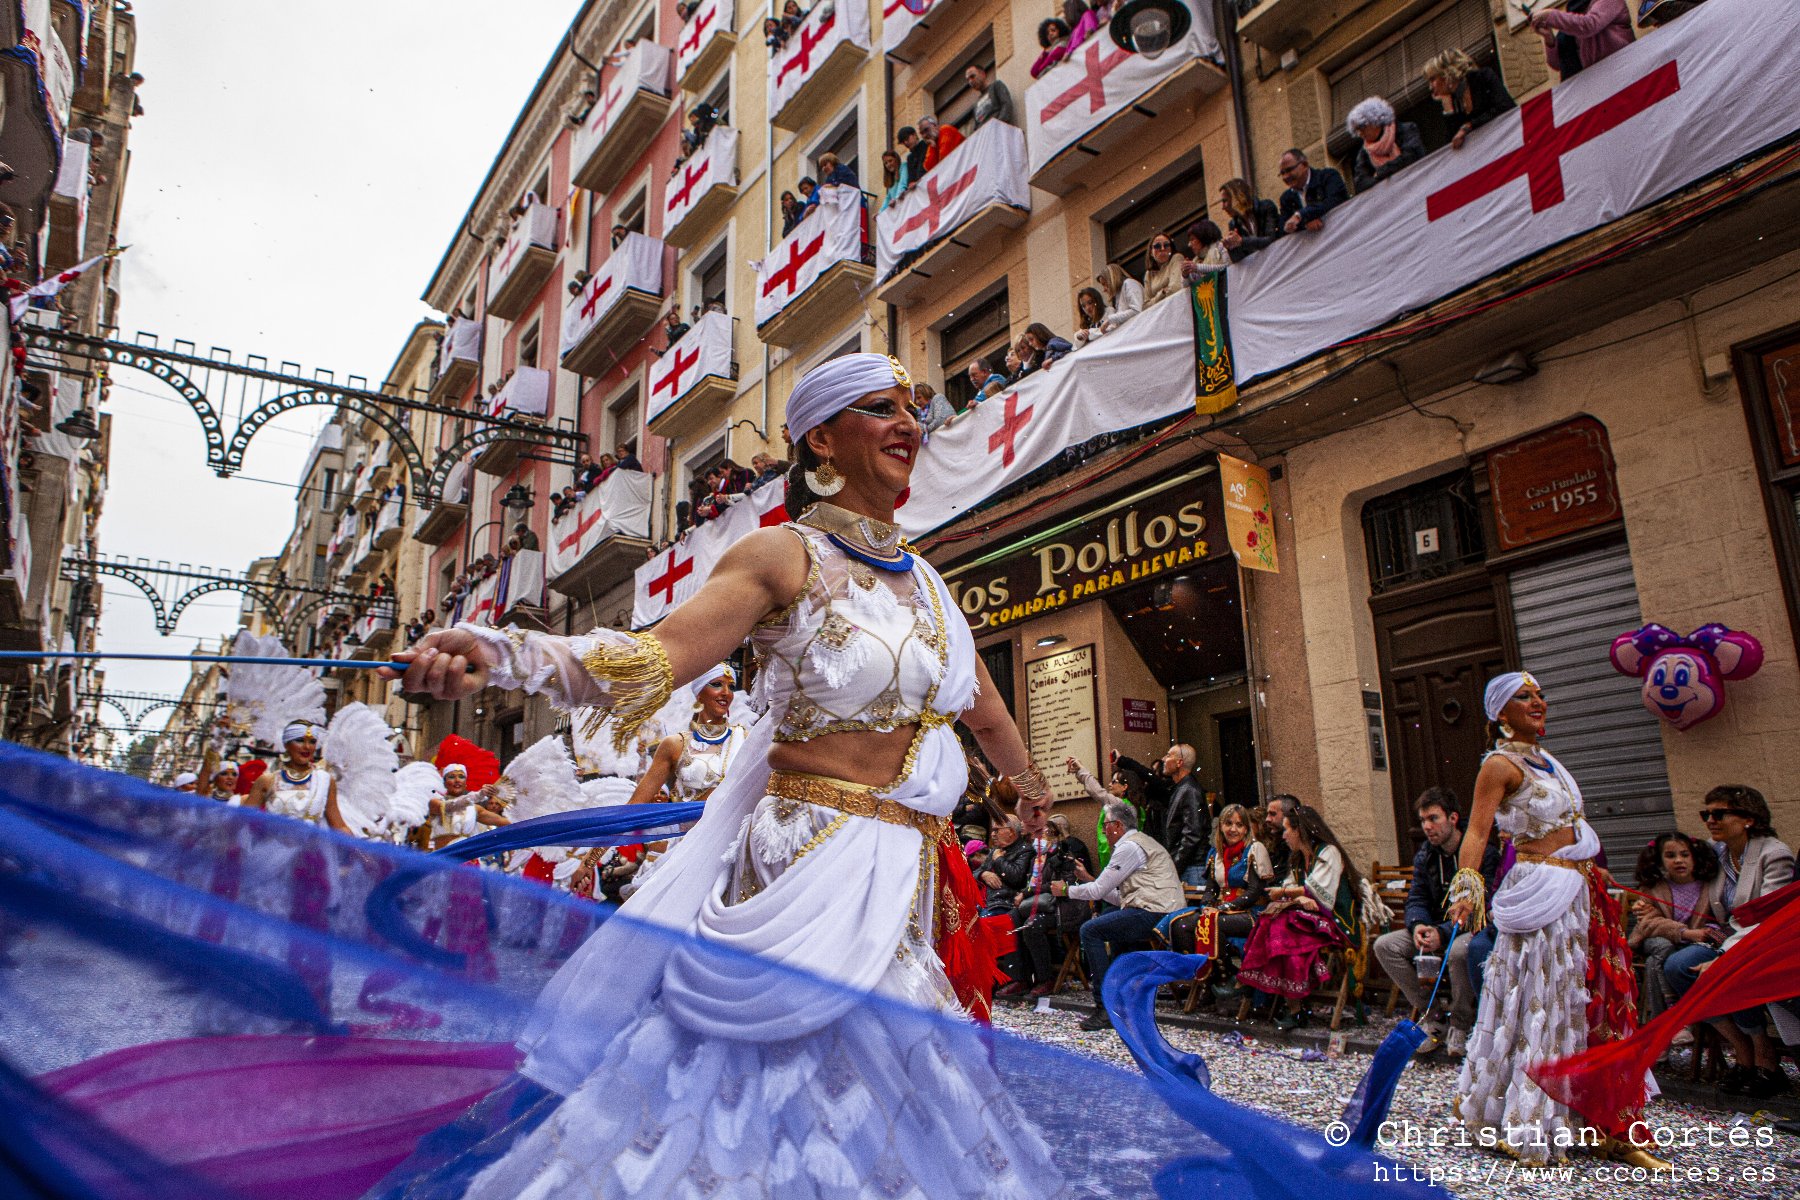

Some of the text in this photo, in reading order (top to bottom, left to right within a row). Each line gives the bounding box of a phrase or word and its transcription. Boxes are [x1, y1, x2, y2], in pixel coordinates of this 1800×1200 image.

[1526, 469, 1597, 499] Casa Fundada
[1530, 483, 1598, 512] en 1955
[1032, 501, 1206, 596] Pollos
[1423, 534, 1431, 547] 6
[989, 540, 1209, 626] COMIDAS PARA LLEVAR
[1030, 666, 1092, 693] Comidas Diarias
